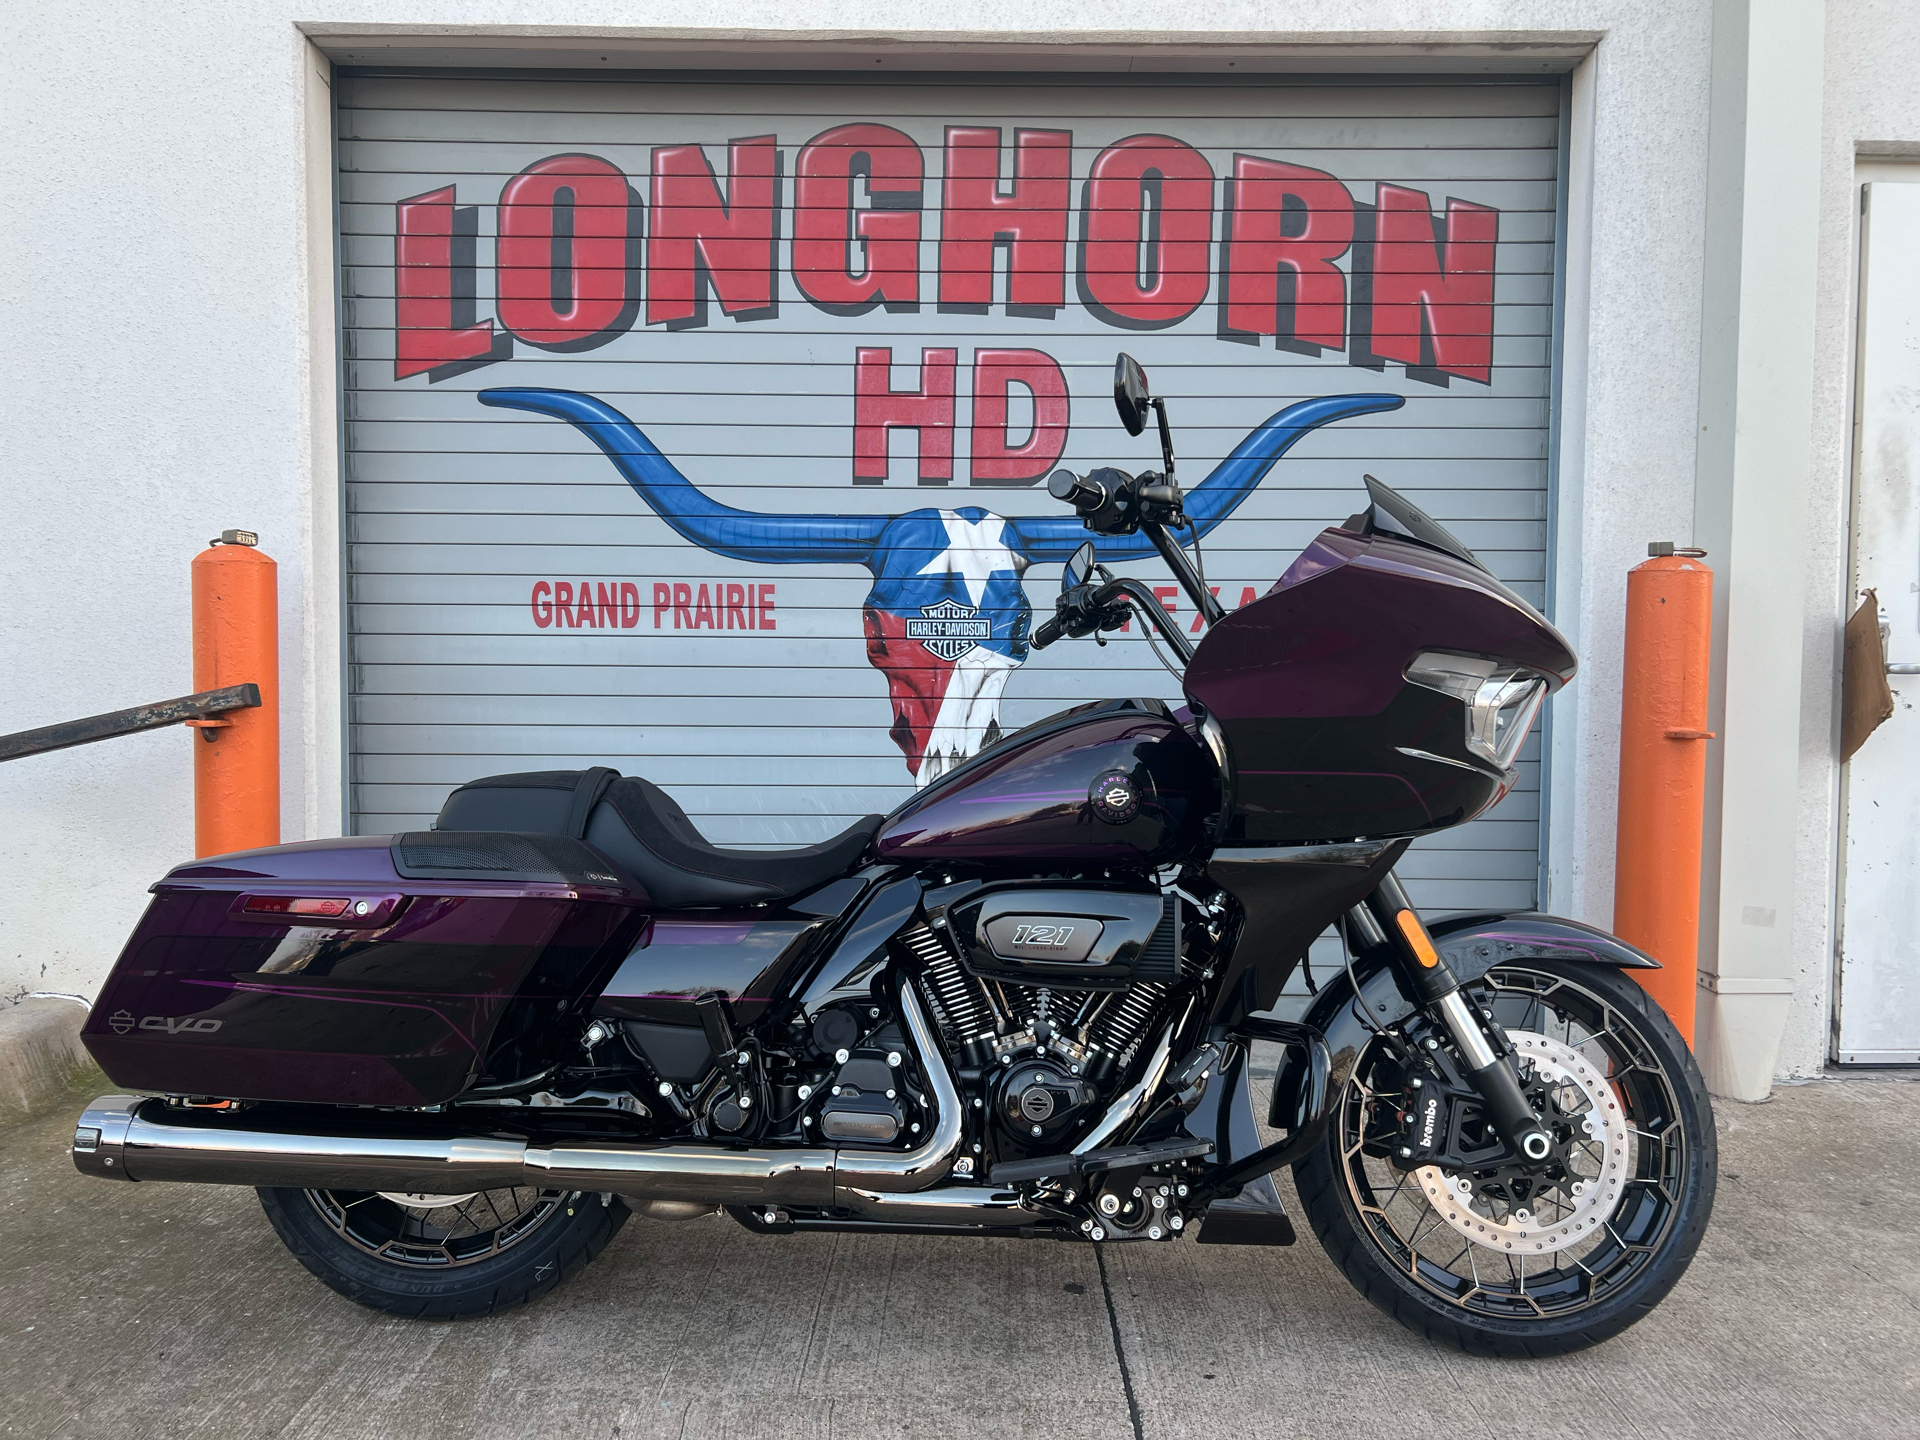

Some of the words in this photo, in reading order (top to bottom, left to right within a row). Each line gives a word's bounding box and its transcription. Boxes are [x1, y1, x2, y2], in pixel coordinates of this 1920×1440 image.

[394, 122, 1500, 388] LONGHORN
[852, 347, 1071, 486] HD
[531, 580, 641, 629] GRAND
[653, 582, 777, 631] PRAIRIE
[928, 603, 969, 619] MOTOR
[910, 622, 987, 636] HARLEY-DAVIDSON
[928, 639, 969, 658] CYCLES
[1012, 925, 1075, 946] 121
[139, 1016, 223, 1035] CVO
[1420, 1099, 1437, 1147] brembo
